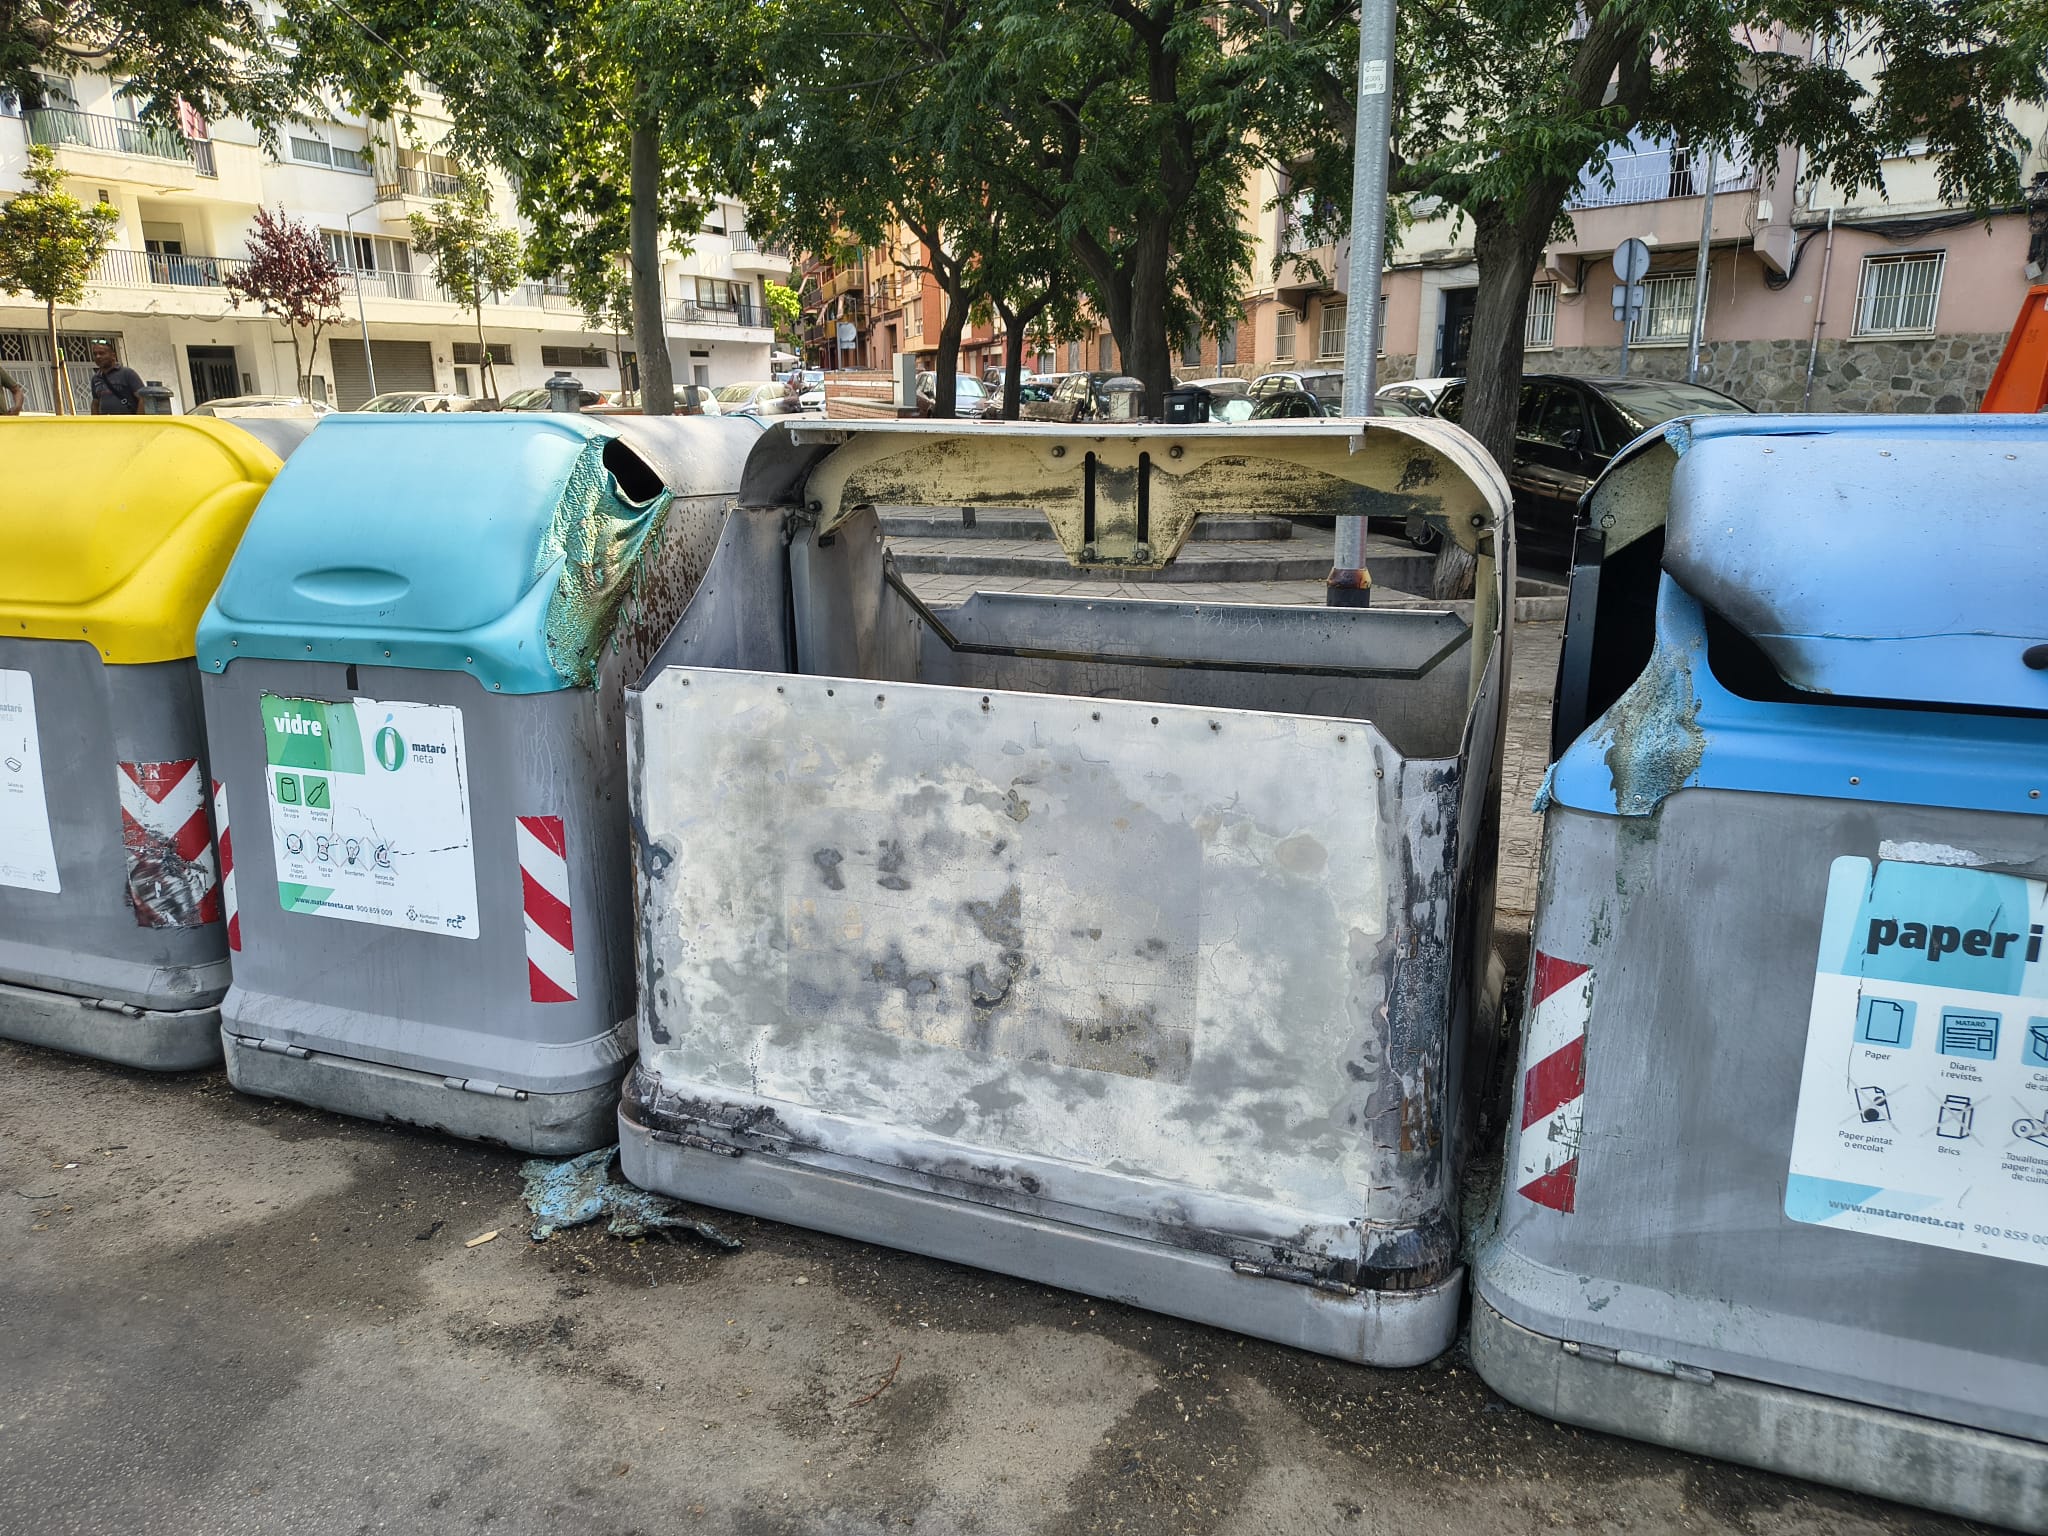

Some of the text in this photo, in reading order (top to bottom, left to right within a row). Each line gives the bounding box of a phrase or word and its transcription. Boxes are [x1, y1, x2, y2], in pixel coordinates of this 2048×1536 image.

[273, 712, 322, 737] vidre
[411, 742, 447, 754] mataró
[412, 753, 434, 764] neta
[294, 896, 354, 911] www.mataroneta.cat
[356, 904, 369, 913] 900
[1866, 918, 2044, 963] paper i
[1864, 1050, 1891, 1061] Paper
[1950, 1061, 1977, 1072] Diaris
[1946, 1071, 1983, 1083] revistes
[2025, 1081, 2037, 1090] de
[1838, 1130, 1893, 1146] Paper pintat
[1851, 1142, 1884, 1153] encolat
[1937, 1145, 1961, 1156] Brics
[2001, 1163, 2029, 1172] paper
[2036, 1168, 2048, 1176] pa
[2011, 1172, 2024, 1181] de
[1828, 1199, 2048, 1246] www.mataroneta.cat 900 859 00
